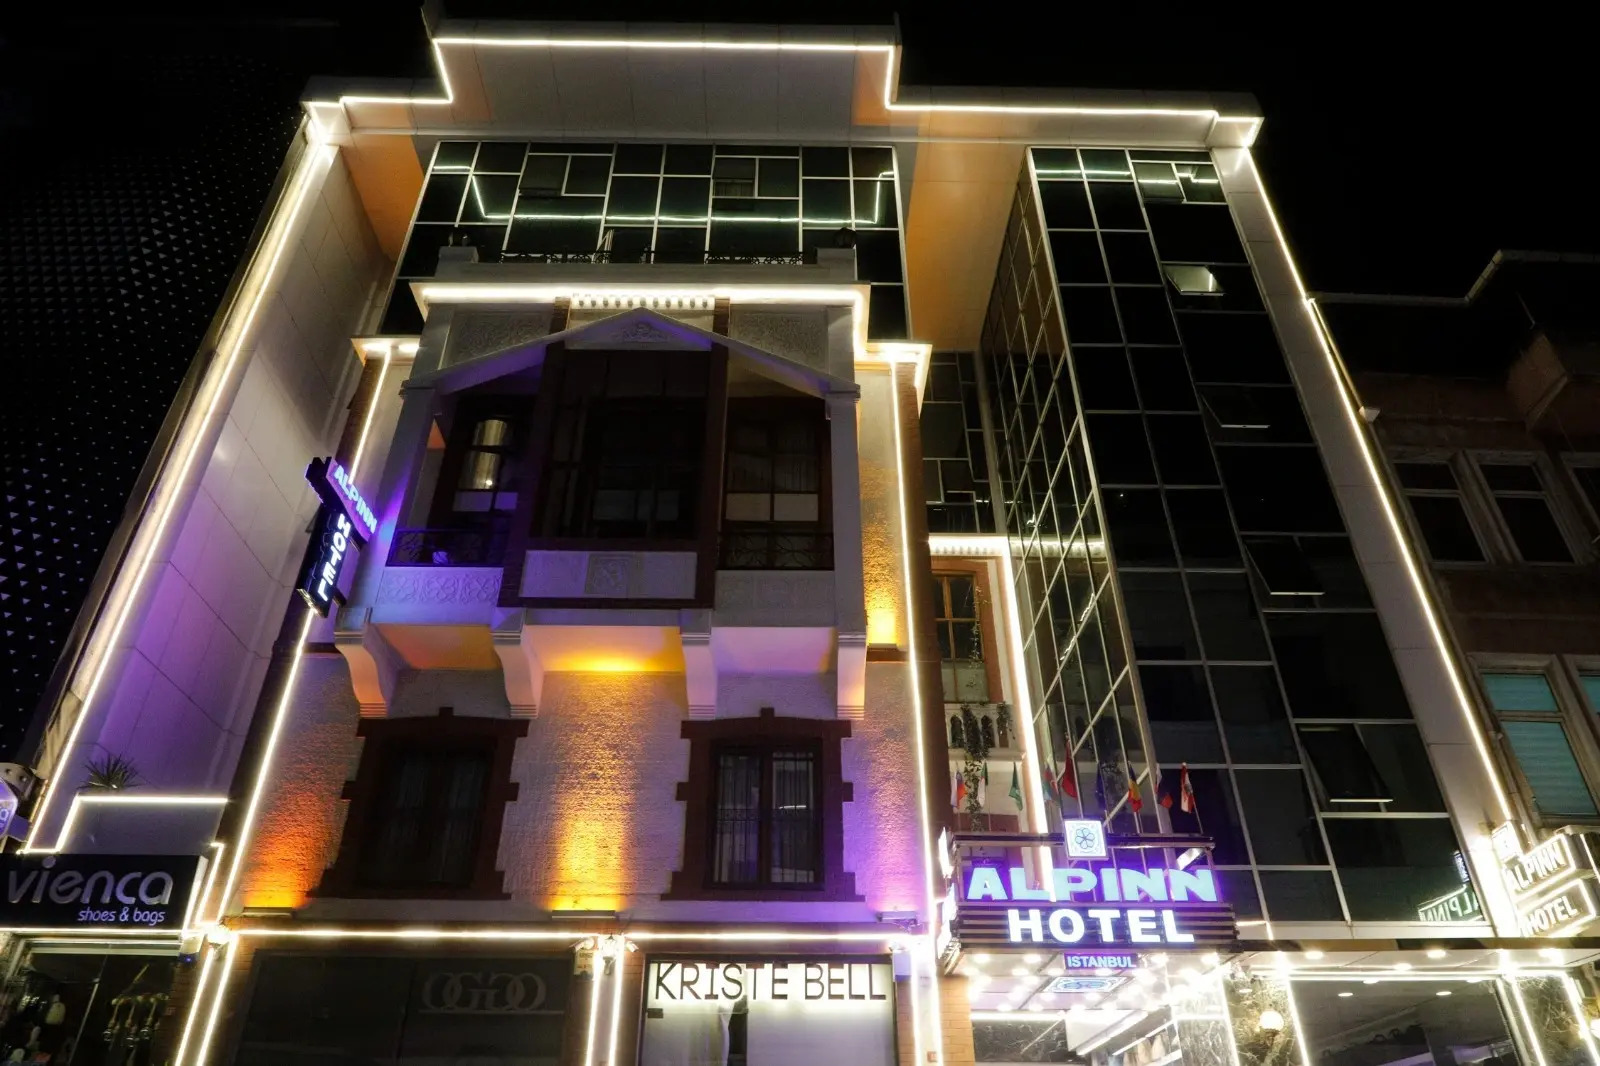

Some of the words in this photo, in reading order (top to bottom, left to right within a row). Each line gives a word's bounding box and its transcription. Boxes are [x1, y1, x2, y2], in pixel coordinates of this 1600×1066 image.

[334, 465, 377, 534] ALPINN
[317, 513, 351, 601] HOTEL
[8, 856, 174, 904] vienca
[967, 867, 1218, 901] ALPINN
[1503, 841, 1567, 893] ALPINN
[77, 907, 116, 921] shoes
[119, 907, 129, 921] &
[133, 908, 165, 926] bags
[1007, 908, 1195, 943] HOTEL
[1521, 896, 1578, 937] HOTEL
[655, 962, 788, 1000] KRISTE
[805, 963, 887, 1000] BELL
[1067, 956, 1137, 968] ISTANBUL
